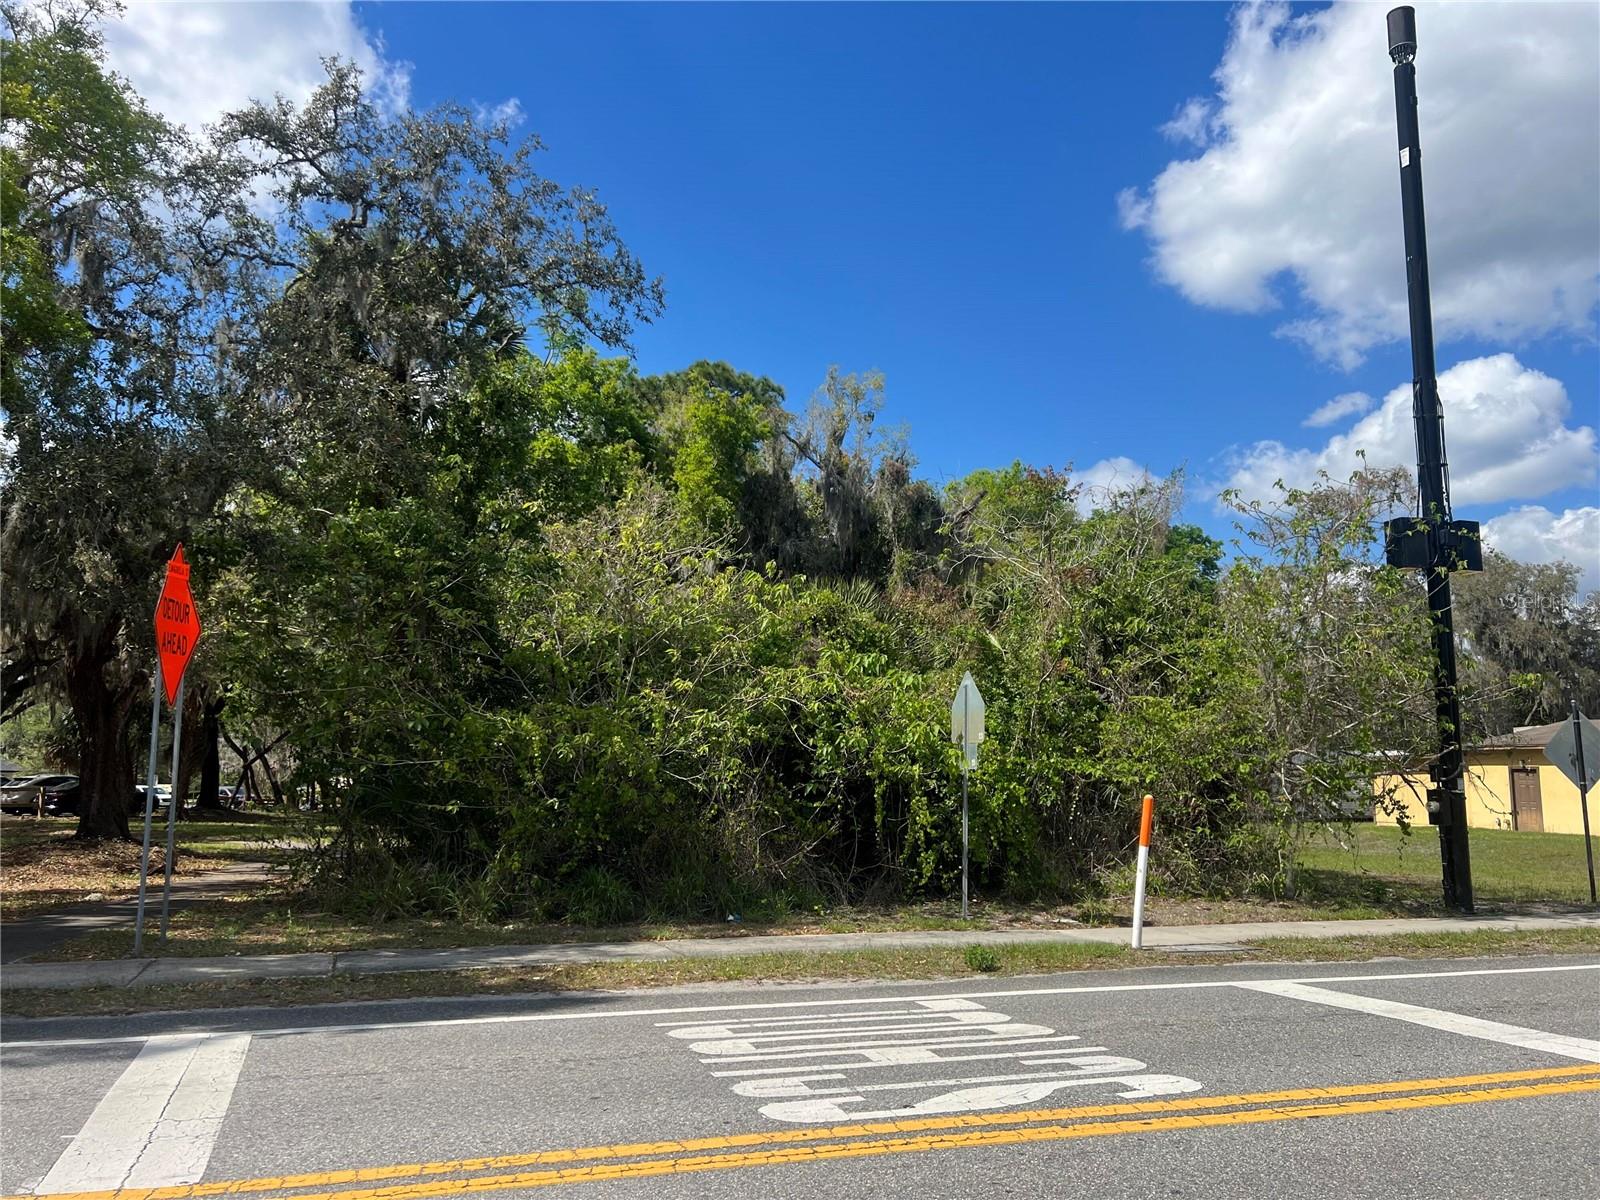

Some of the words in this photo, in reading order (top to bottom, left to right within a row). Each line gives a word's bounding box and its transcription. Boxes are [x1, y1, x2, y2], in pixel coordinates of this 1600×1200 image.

[162, 597, 190, 624] DETOUR
[161, 631, 188, 656] AHEAD
[654, 998, 1203, 1123] SCHOOL
